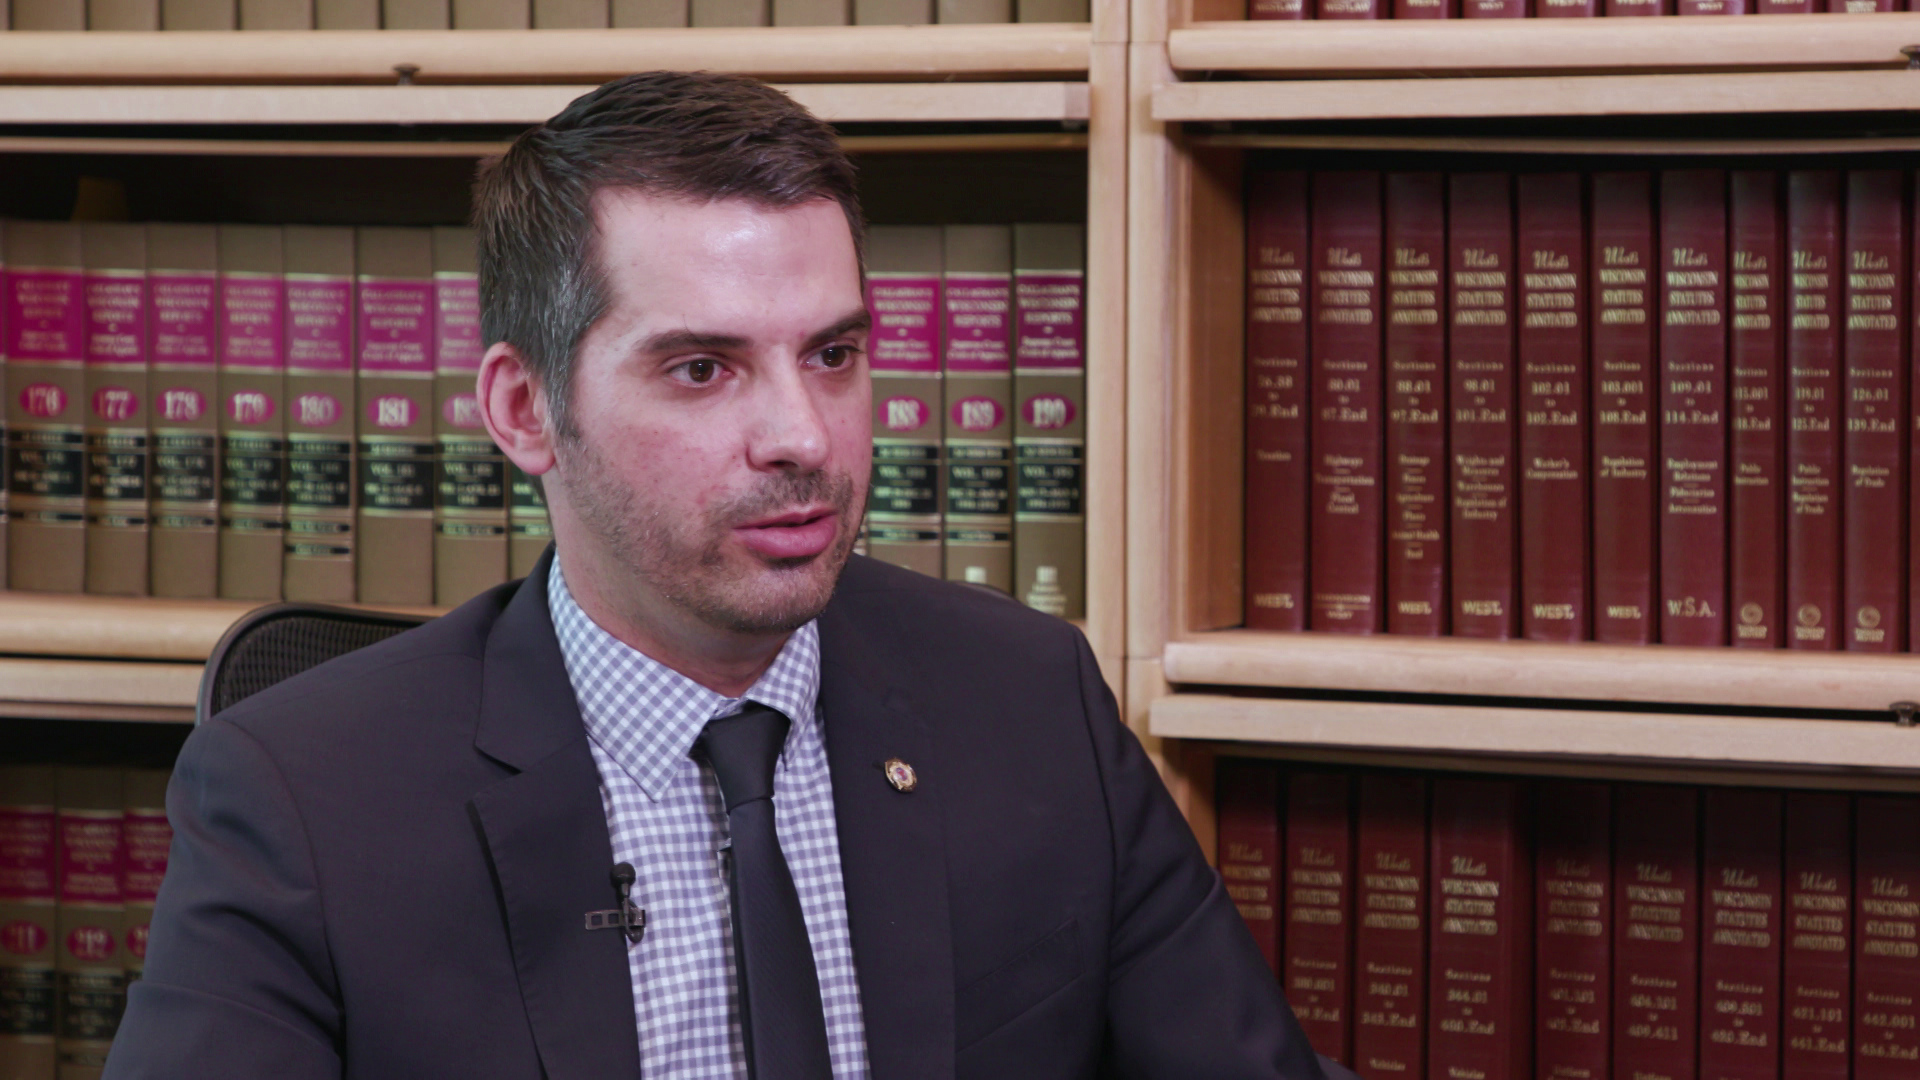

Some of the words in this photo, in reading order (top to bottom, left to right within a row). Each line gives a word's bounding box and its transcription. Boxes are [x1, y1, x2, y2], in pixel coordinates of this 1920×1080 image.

[1318, 271, 1374, 287] WISCONSIN
[1389, 270, 1438, 286] WISCONSIN
[1454, 271, 1506, 287] WISCONSIN
[1524, 273, 1577, 289] WISCONSIN
[1599, 269, 1646, 285] WISCONSIN
[1665, 271, 1718, 287] WISCONSIN
[1792, 273, 1828, 288] WISCONSIN
[1849, 273, 1895, 289] WISCONSIN
[1320, 289, 1371, 306] STATUTES
[1392, 290, 1436, 306] STATUTES
[1456, 290, 1504, 307] STATUTES
[1525, 292, 1575, 309] STATUTES
[1601, 289, 1644, 305] STATUTES
[1668, 290, 1715, 307] STATUTES
[1795, 294, 1826, 310] STATUTES
[1852, 294, 1892, 310] STATUTES
[1320, 308, 1373, 325] ANNOTATED
[1392, 309, 1438, 325] ANNOTATED
[1455, 309, 1506, 326] ANNOTATED
[1525, 311, 1577, 328] ANNOTATED
[1601, 308, 1646, 325] ANNOTATED
[1665, 309, 1721, 326] ANNOTATED
[1792, 314, 1830, 330] ANNOTATED
[1848, 314, 1897, 330] ANNOTATED
[1322, 358, 1368, 371] Sections
[1392, 359, 1436, 371] Sections
[1456, 359, 1504, 371] Sections
[1526, 361, 1576, 374] Sections
[1603, 360, 1641, 372] Sections
[1668, 360, 1714, 372] Sections
[1849, 366, 1893, 378] Sections
[99, 390, 131, 420] 177
[165, 391, 200, 420] 178
[300, 395, 335, 425] 180
[377, 397, 410, 427] 181
[1033, 398, 1066, 428] 190
[962, 400, 995, 430] 189
[1667, 595, 1717, 618] W.S.A.
[1793, 894, 1847, 911] WISCONSIN
[1862, 899, 1919, 918] WISCONSIN
[1796, 914, 1844, 933] STATUTES
[1866, 919, 1916, 938] STATUTES
[1793, 934, 1846, 951] ANNOTATED
[1864, 940, 1919, 958] ANNOTATED
